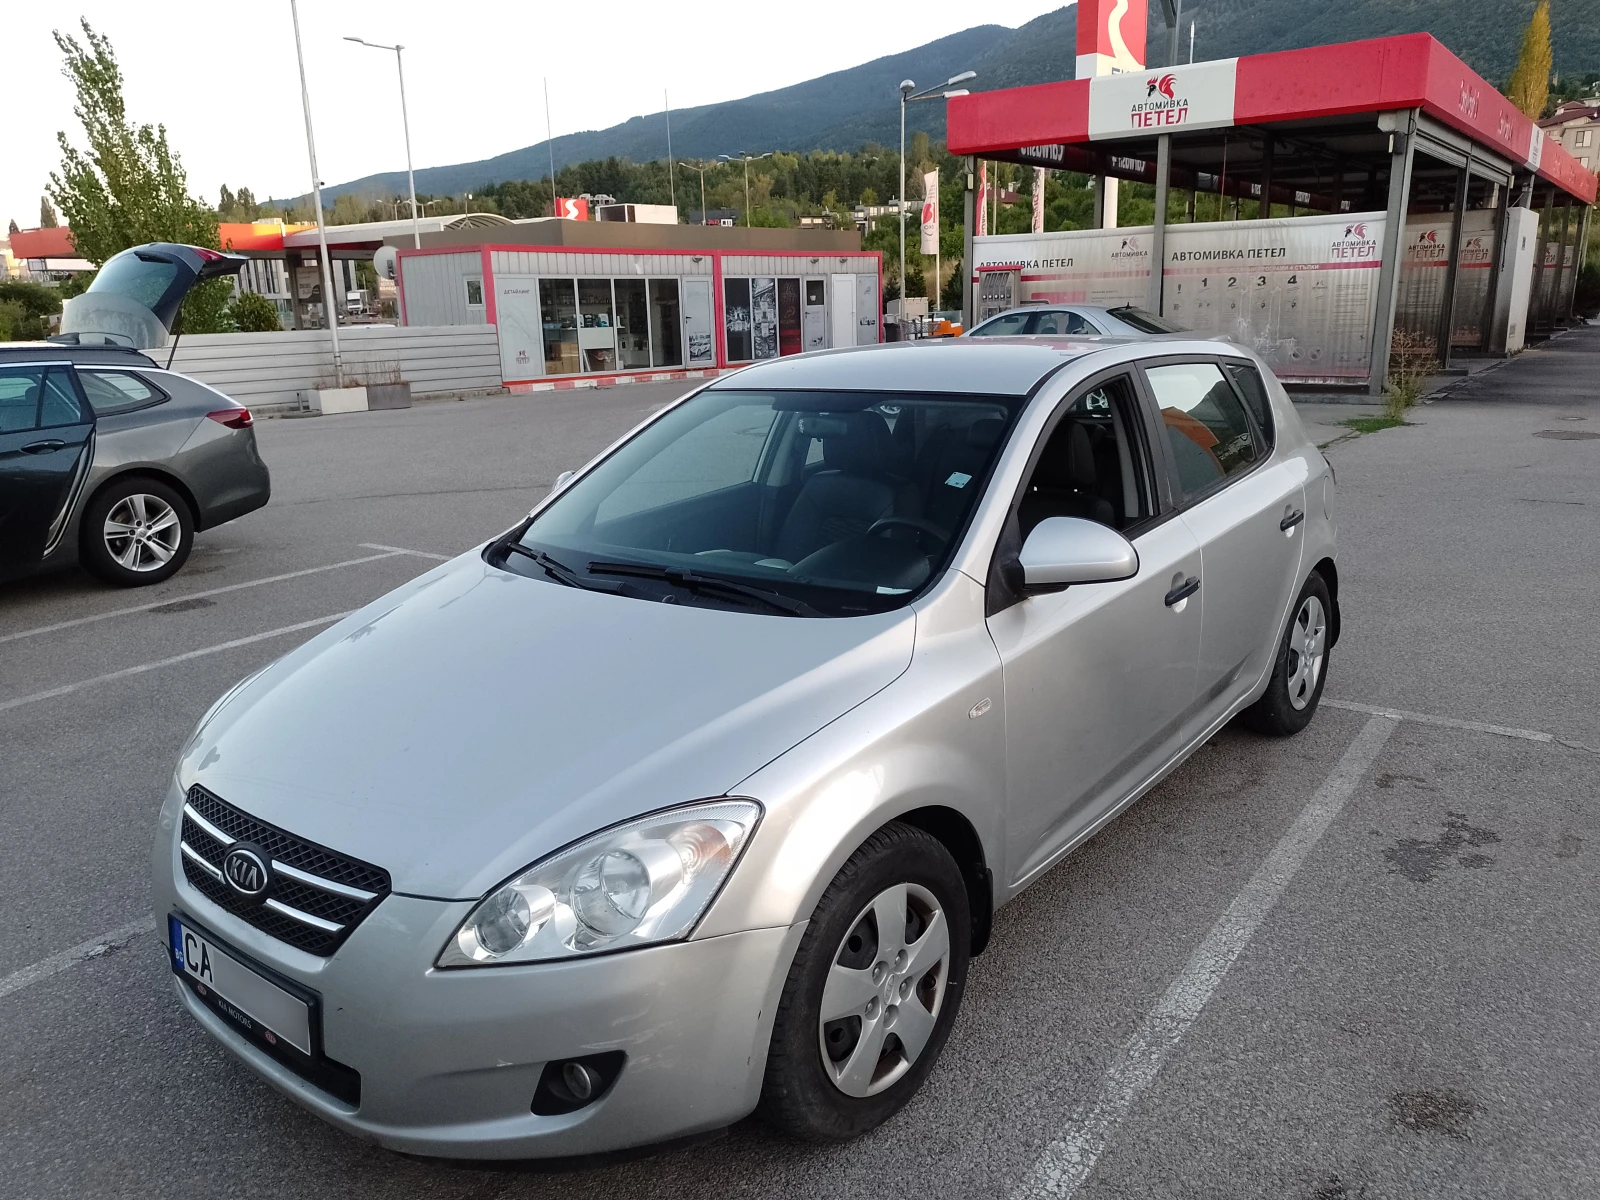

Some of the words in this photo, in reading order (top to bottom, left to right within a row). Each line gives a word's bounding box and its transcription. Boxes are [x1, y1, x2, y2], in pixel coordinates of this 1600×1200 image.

[1131, 98, 1189, 112] АВТОМИВКА
[1131, 107, 1189, 128] ПЕТЕЛ
[1331, 239, 1377, 248] АВТОМИВКА
[1172, 250, 1244, 261] АВТОМИВКА
[1247, 247, 1286, 259] ПЕТЕЛ
[1331, 245, 1376, 258] ПЕТЕЛ
[1042, 257, 1074, 268] ПЕТЕЛ
[1201, 277, 1209, 288] 1
[1227, 276, 1237, 288] 2
[1257, 275, 1267, 287] 3
[1287, 274, 1298, 286] 4
[228, 855, 258, 890] KIA
[184, 931, 214, 984] CA
[218, 999, 228, 1013] KIA
[228, 1006, 252, 1029] MOTORS
